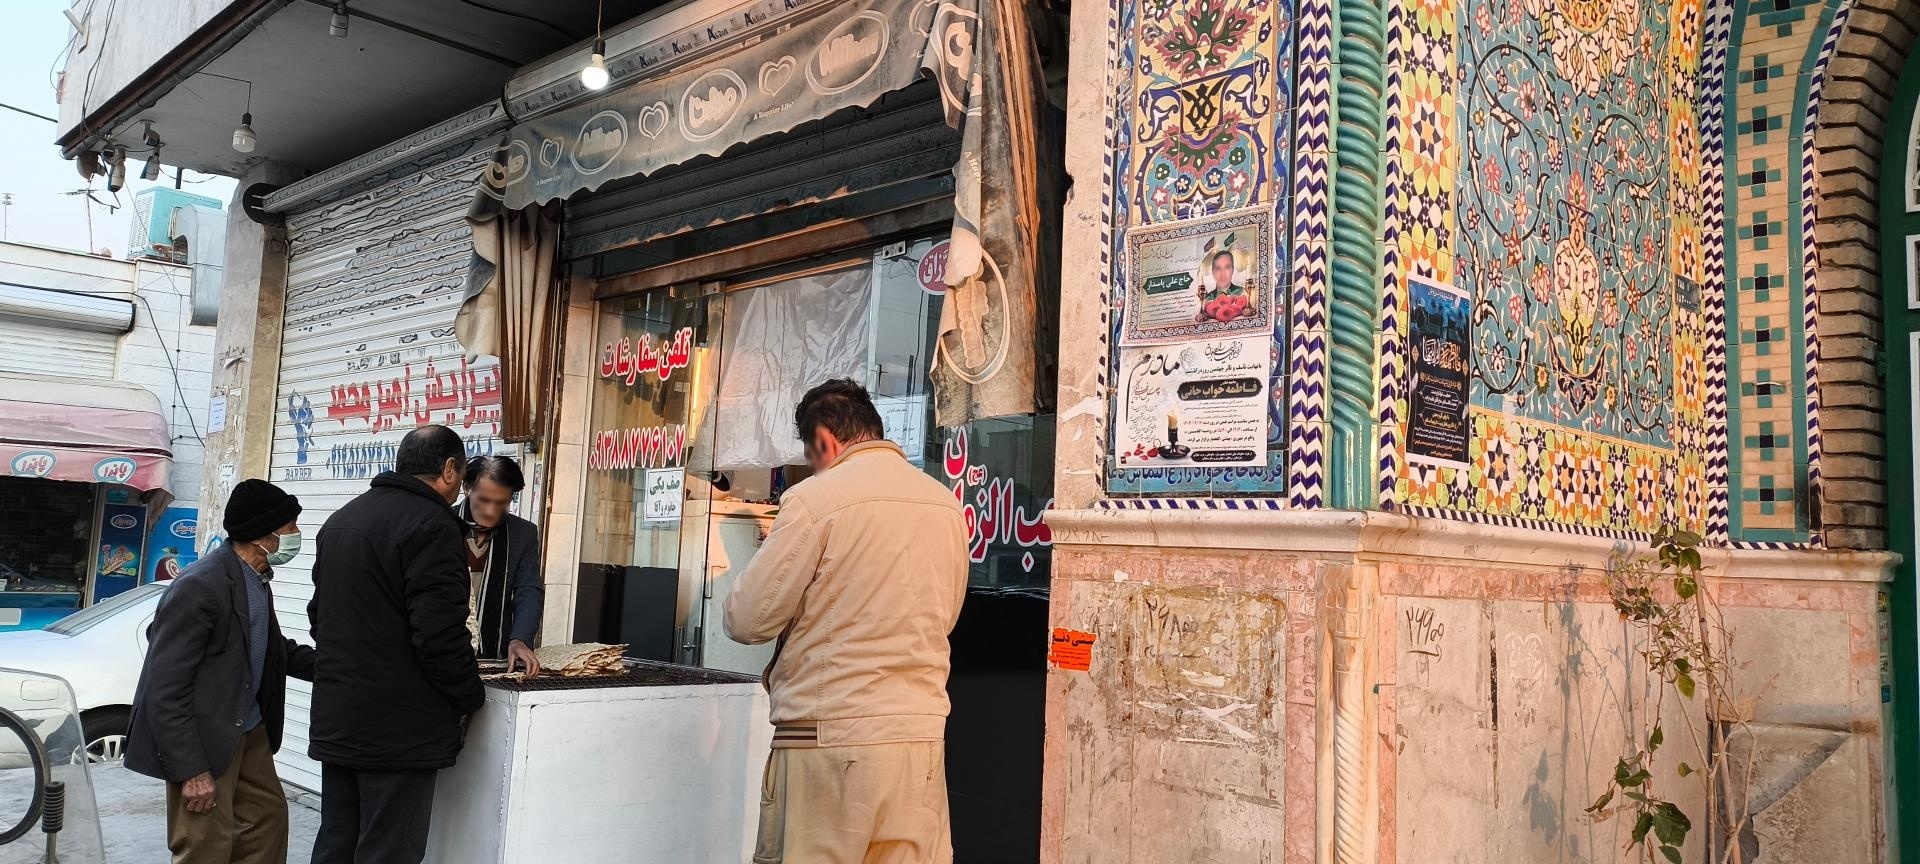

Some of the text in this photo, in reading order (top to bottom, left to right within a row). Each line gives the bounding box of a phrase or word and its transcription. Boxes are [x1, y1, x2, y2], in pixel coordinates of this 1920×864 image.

[1165, 276, 1178, 288] علی
[1178, 274, 1191, 286] حاج
[601, 326, 693, 385] تلفن سفارشات
[373, 363, 410, 434] امیر
[1225, 380, 1258, 394] فاطمه
[328, 381, 371, 425] محمد
